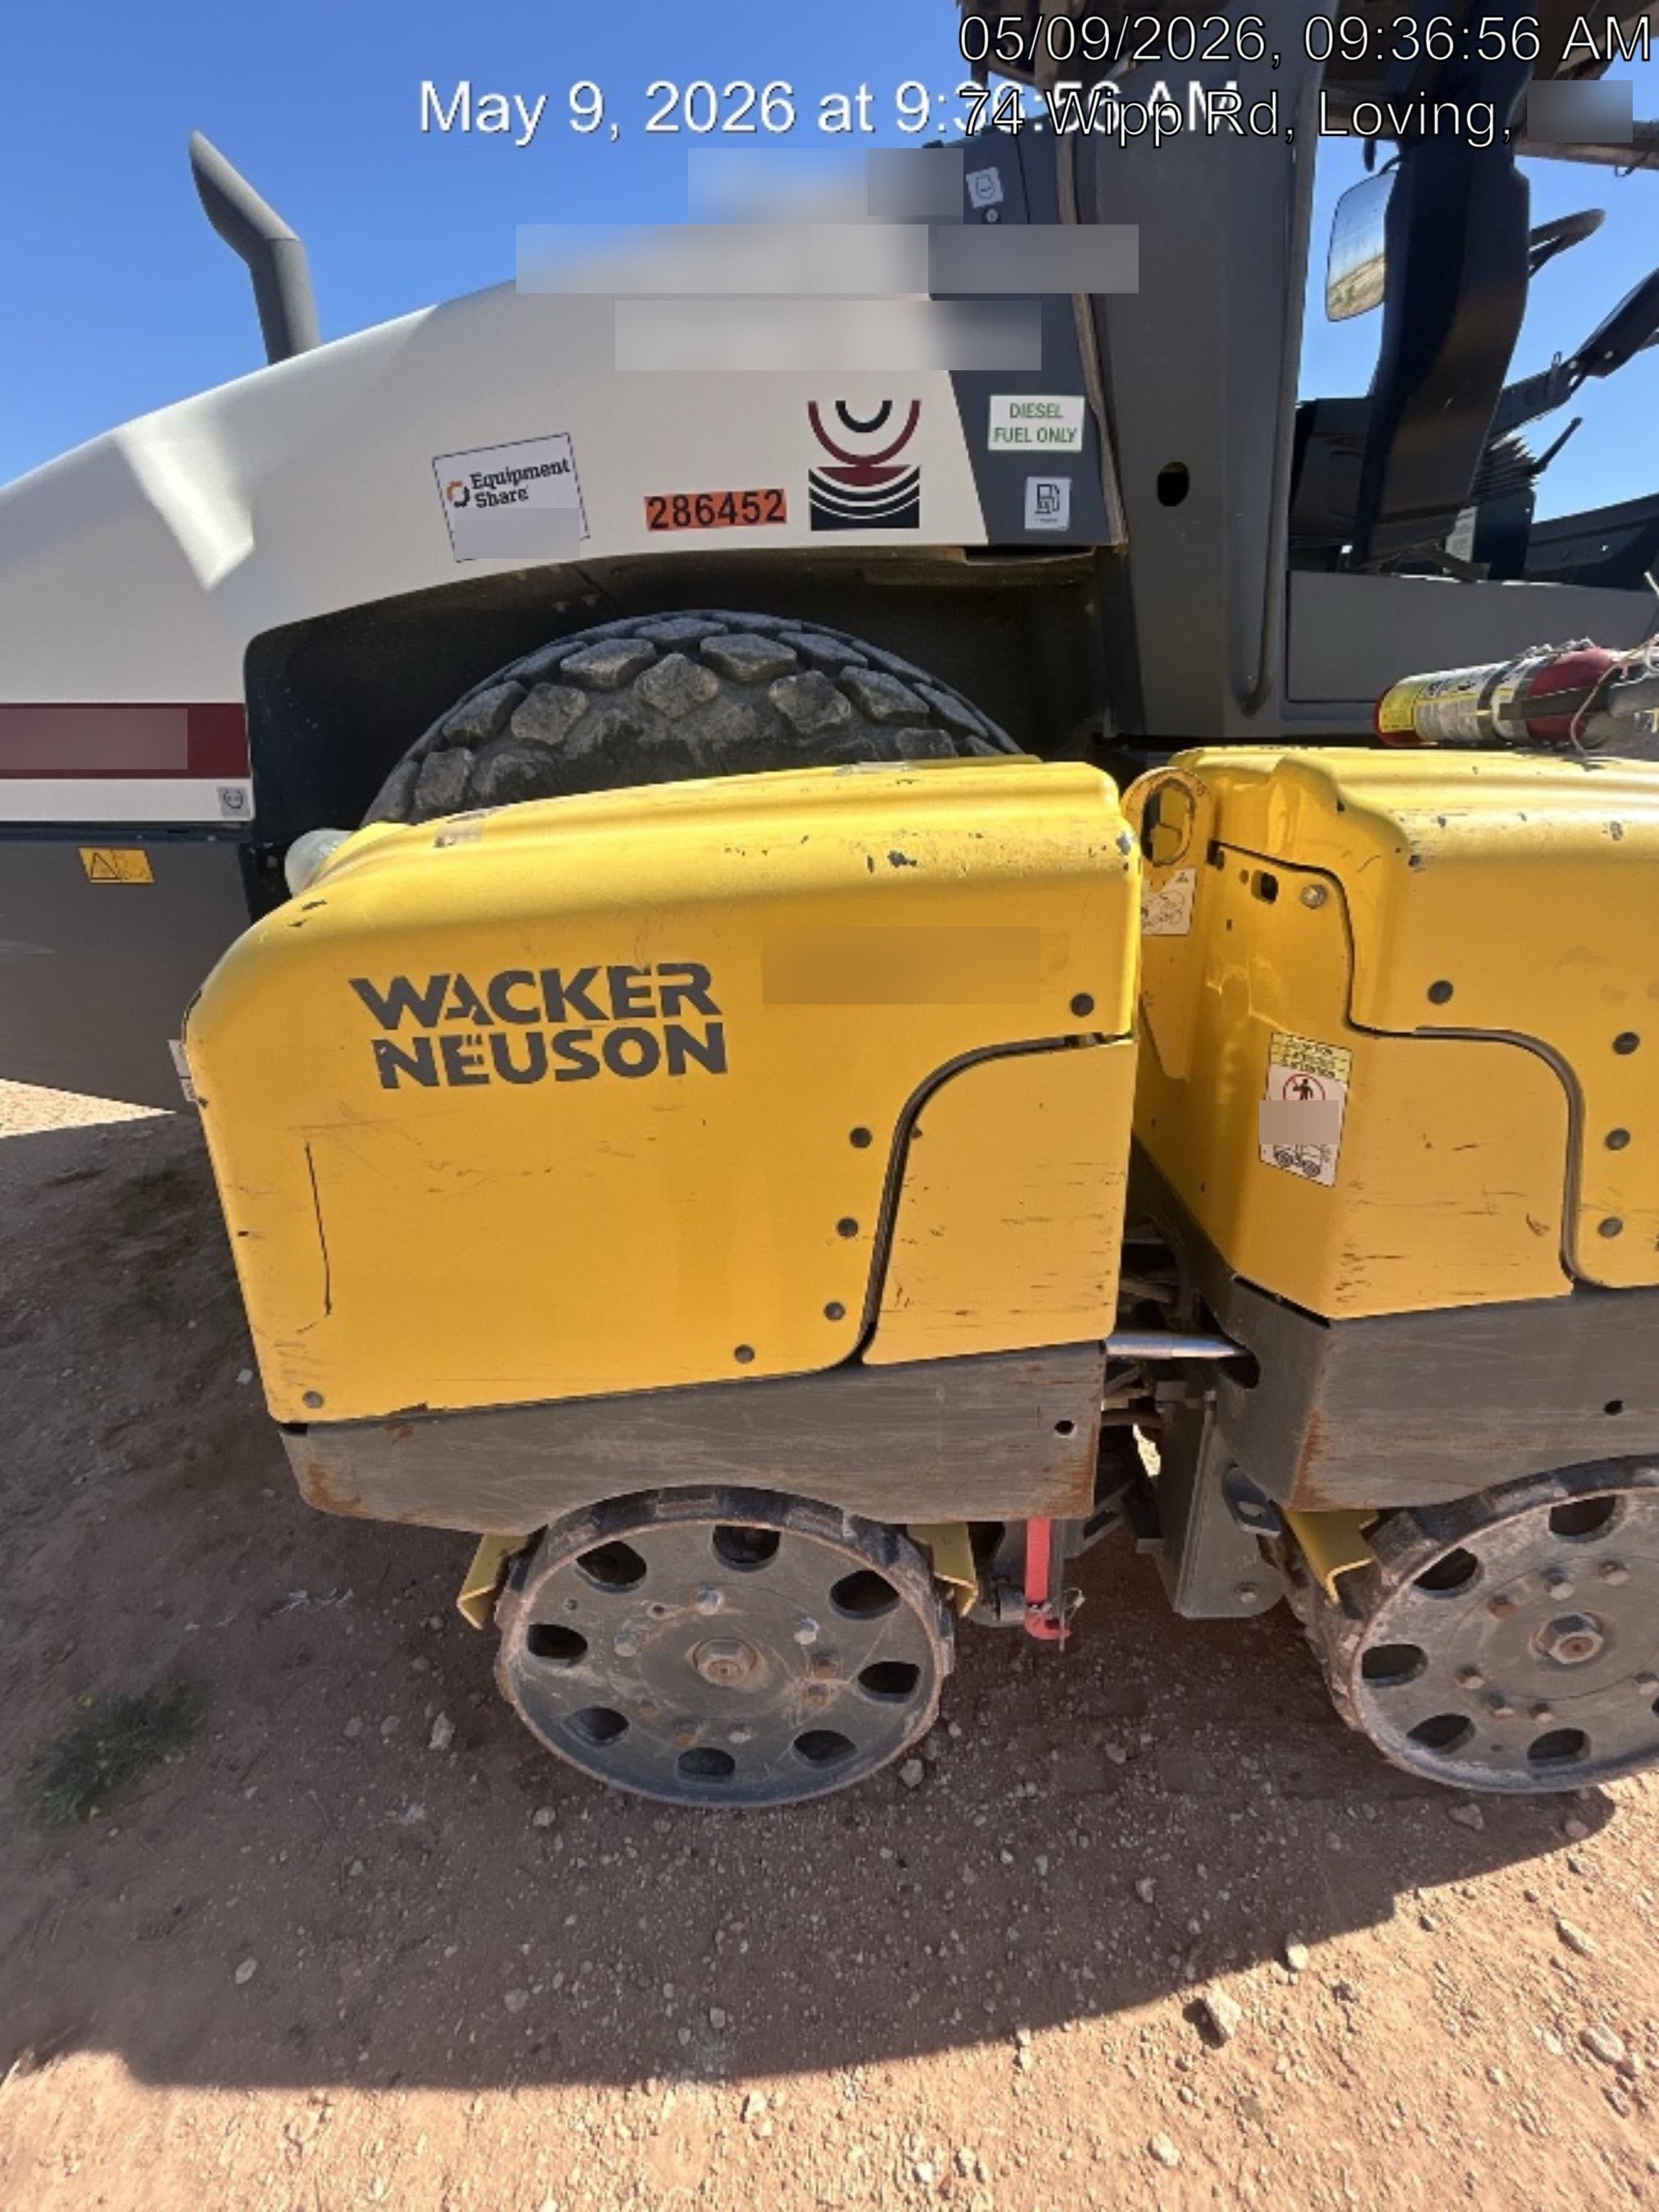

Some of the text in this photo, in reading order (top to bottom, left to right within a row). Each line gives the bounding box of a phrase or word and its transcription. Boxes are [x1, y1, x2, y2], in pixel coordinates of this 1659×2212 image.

[1009, 402, 1064, 419] DIESEL
[994, 427, 1077, 443] FUEL ONLY
[469, 457, 571, 490] Equipment
[474, 487, 529, 508] Share
[647, 489, 786, 530] 286452
[348, 962, 724, 1031] WACKER
[371, 1022, 728, 1090] NEUSON
